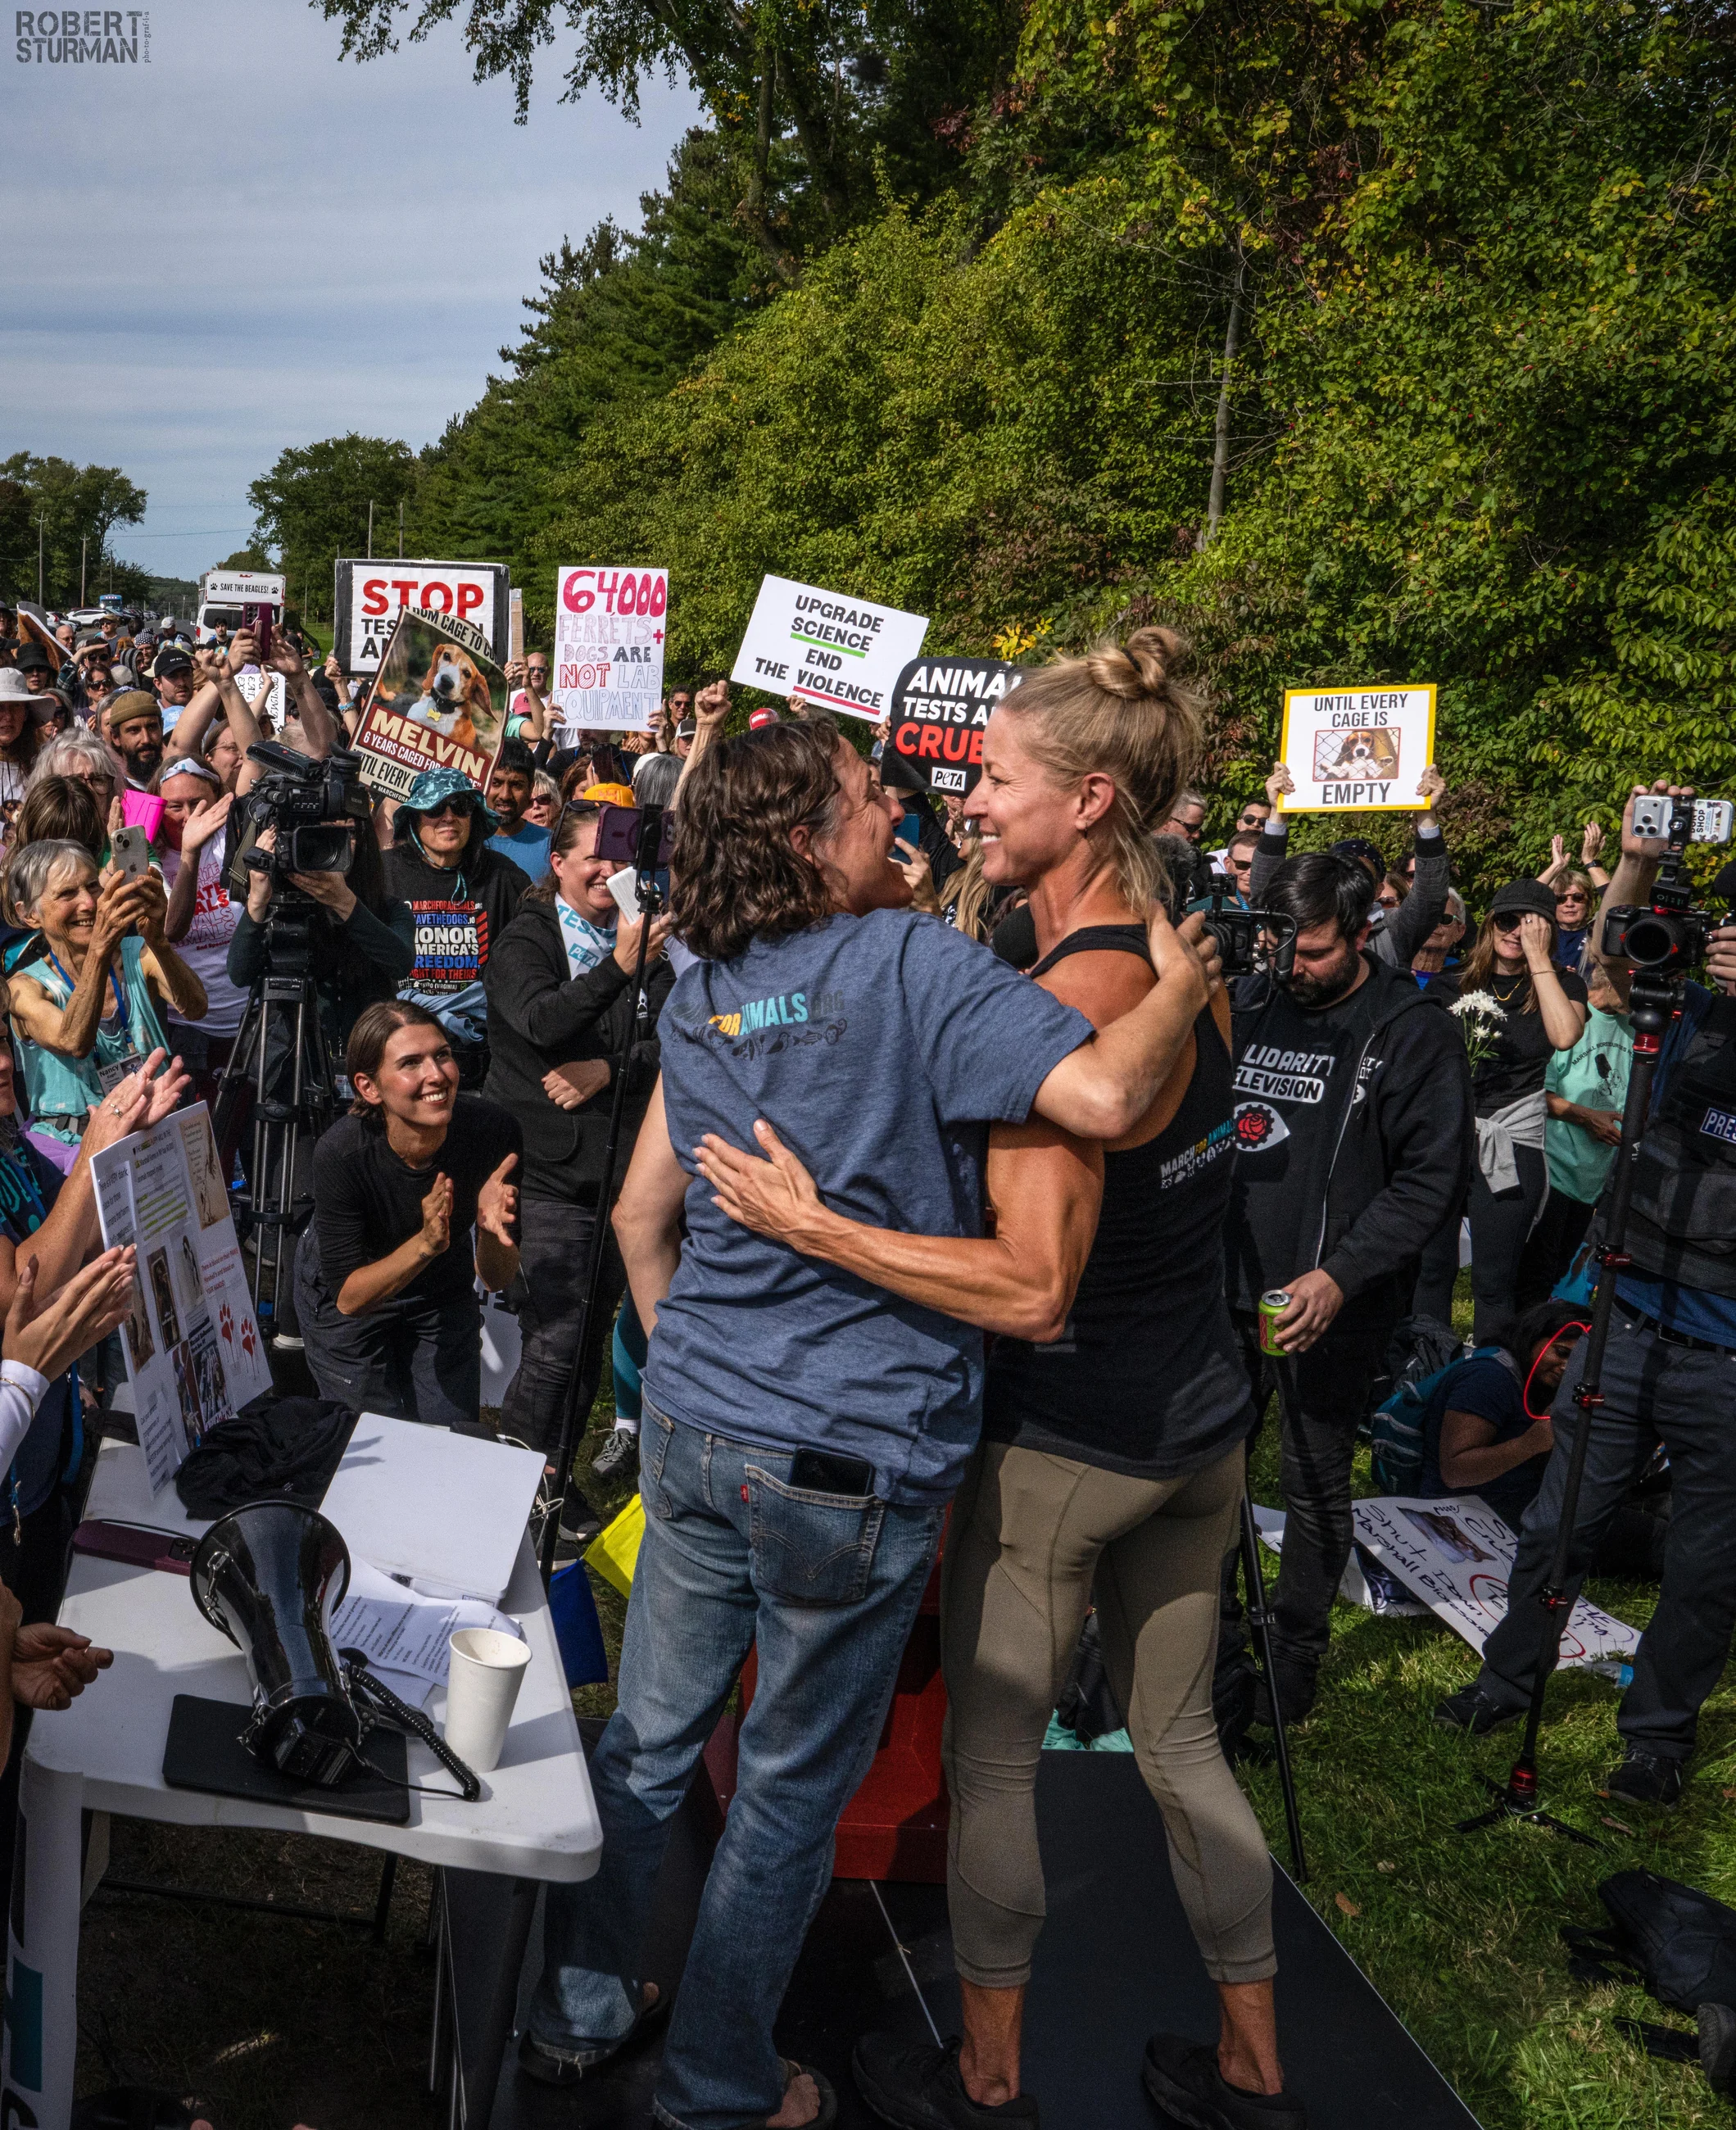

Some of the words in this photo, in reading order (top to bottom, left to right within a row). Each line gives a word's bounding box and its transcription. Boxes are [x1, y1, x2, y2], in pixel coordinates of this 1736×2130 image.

[220, 583, 233, 591] SAVE
[234, 584, 244, 592] THE
[246, 585, 269, 594] BEAGLES!
[361, 579, 484, 619] STOP
[361, 619, 397, 635] TES
[795, 595, 884, 632] UPGRADE
[406, 605, 439, 623] ROM
[441, 613, 469, 642] CAGE
[469, 632, 483, 651] TO
[791, 617, 873, 651] SCIENCE
[564, 644, 608, 663] DOGS
[613, 646, 650, 663] ARE
[805, 648, 842, 671] END
[560, 663, 610, 689] NOT
[618, 664, 659, 690] LAB
[755, 657, 789, 680] THE
[797, 669, 883, 708] VIOLENCE
[554, 690, 659, 721] EQUIPMENT
[903, 696, 968, 723] TESTS
[1315, 696, 1356, 711] UNTIL
[1361, 694, 1408, 709] EVERY
[1332, 712, 1370, 727] CAGE
[1375, 711, 1388, 726] IS
[364, 732, 370, 743] 6
[371, 734, 400, 758] YEARS
[397, 746, 424, 767] CAGED
[370, 709, 485, 779] MELVIN
[895, 722, 985, 764] CRUE
[377, 761, 410, 789] EVERY
[378, 786, 409, 803] MARCHFORA
[1322, 782, 1391, 804] EMPTY
[1697, 809, 1706, 833] SHOP
[414, 913, 475, 925] AVETHEDOGS.IO
[415, 944, 478, 955] MERICA'S
[415, 955, 481, 969] REEDOM,
[410, 968, 429, 979] IGHT
[431, 968, 446, 979] FOR
[448, 968, 477, 980] THEIRS
[99, 1065, 119, 1077] Nancy
[1242, 1044, 1335, 1076] LIDARITY
[1352, 1507, 1420, 1573] Marshall
[1465, 1517, 1516, 1562] Crue
[1366, 1504, 1426, 1561] Shut
[1432, 1570, 1482, 1616] Down
